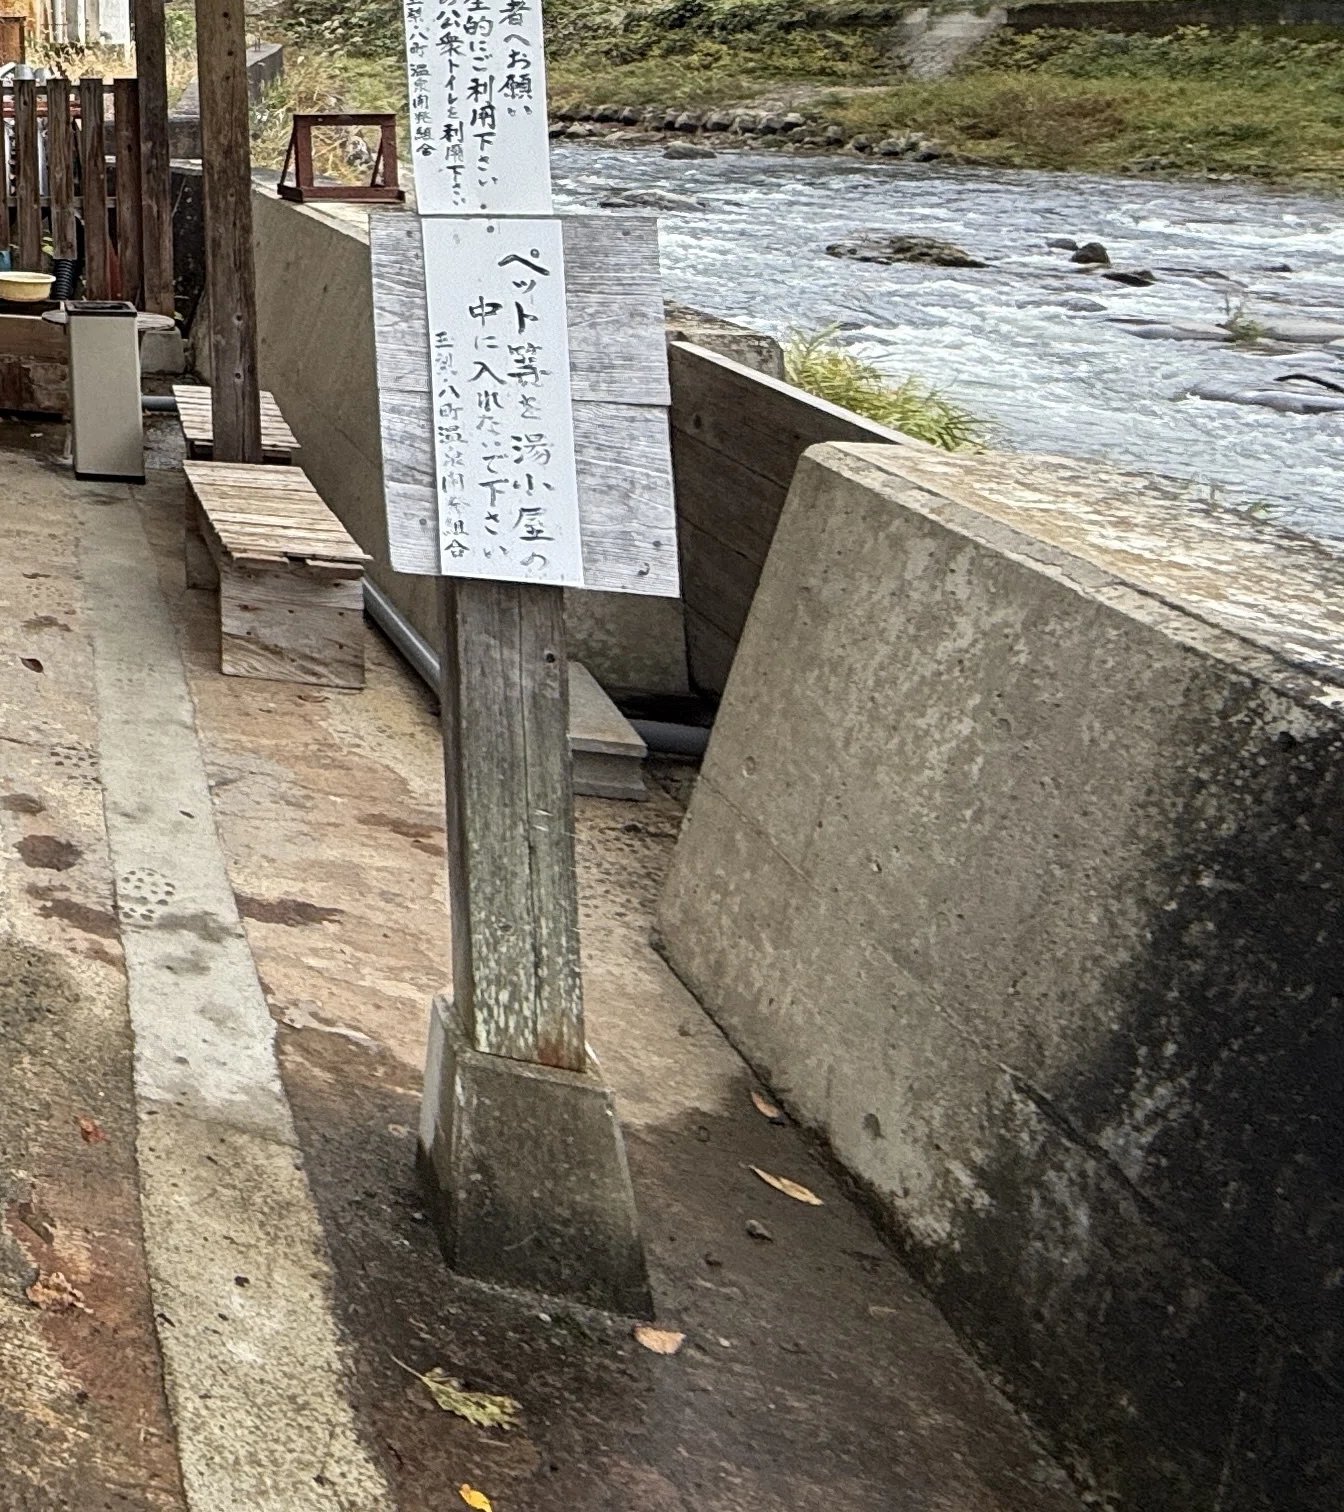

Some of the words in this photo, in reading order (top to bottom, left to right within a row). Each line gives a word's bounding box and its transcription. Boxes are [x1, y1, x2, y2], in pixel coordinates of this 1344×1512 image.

[468, 295, 508, 558] 中に入れないで下さい
[498, 248, 555, 572] ペット等を湯小屋の
